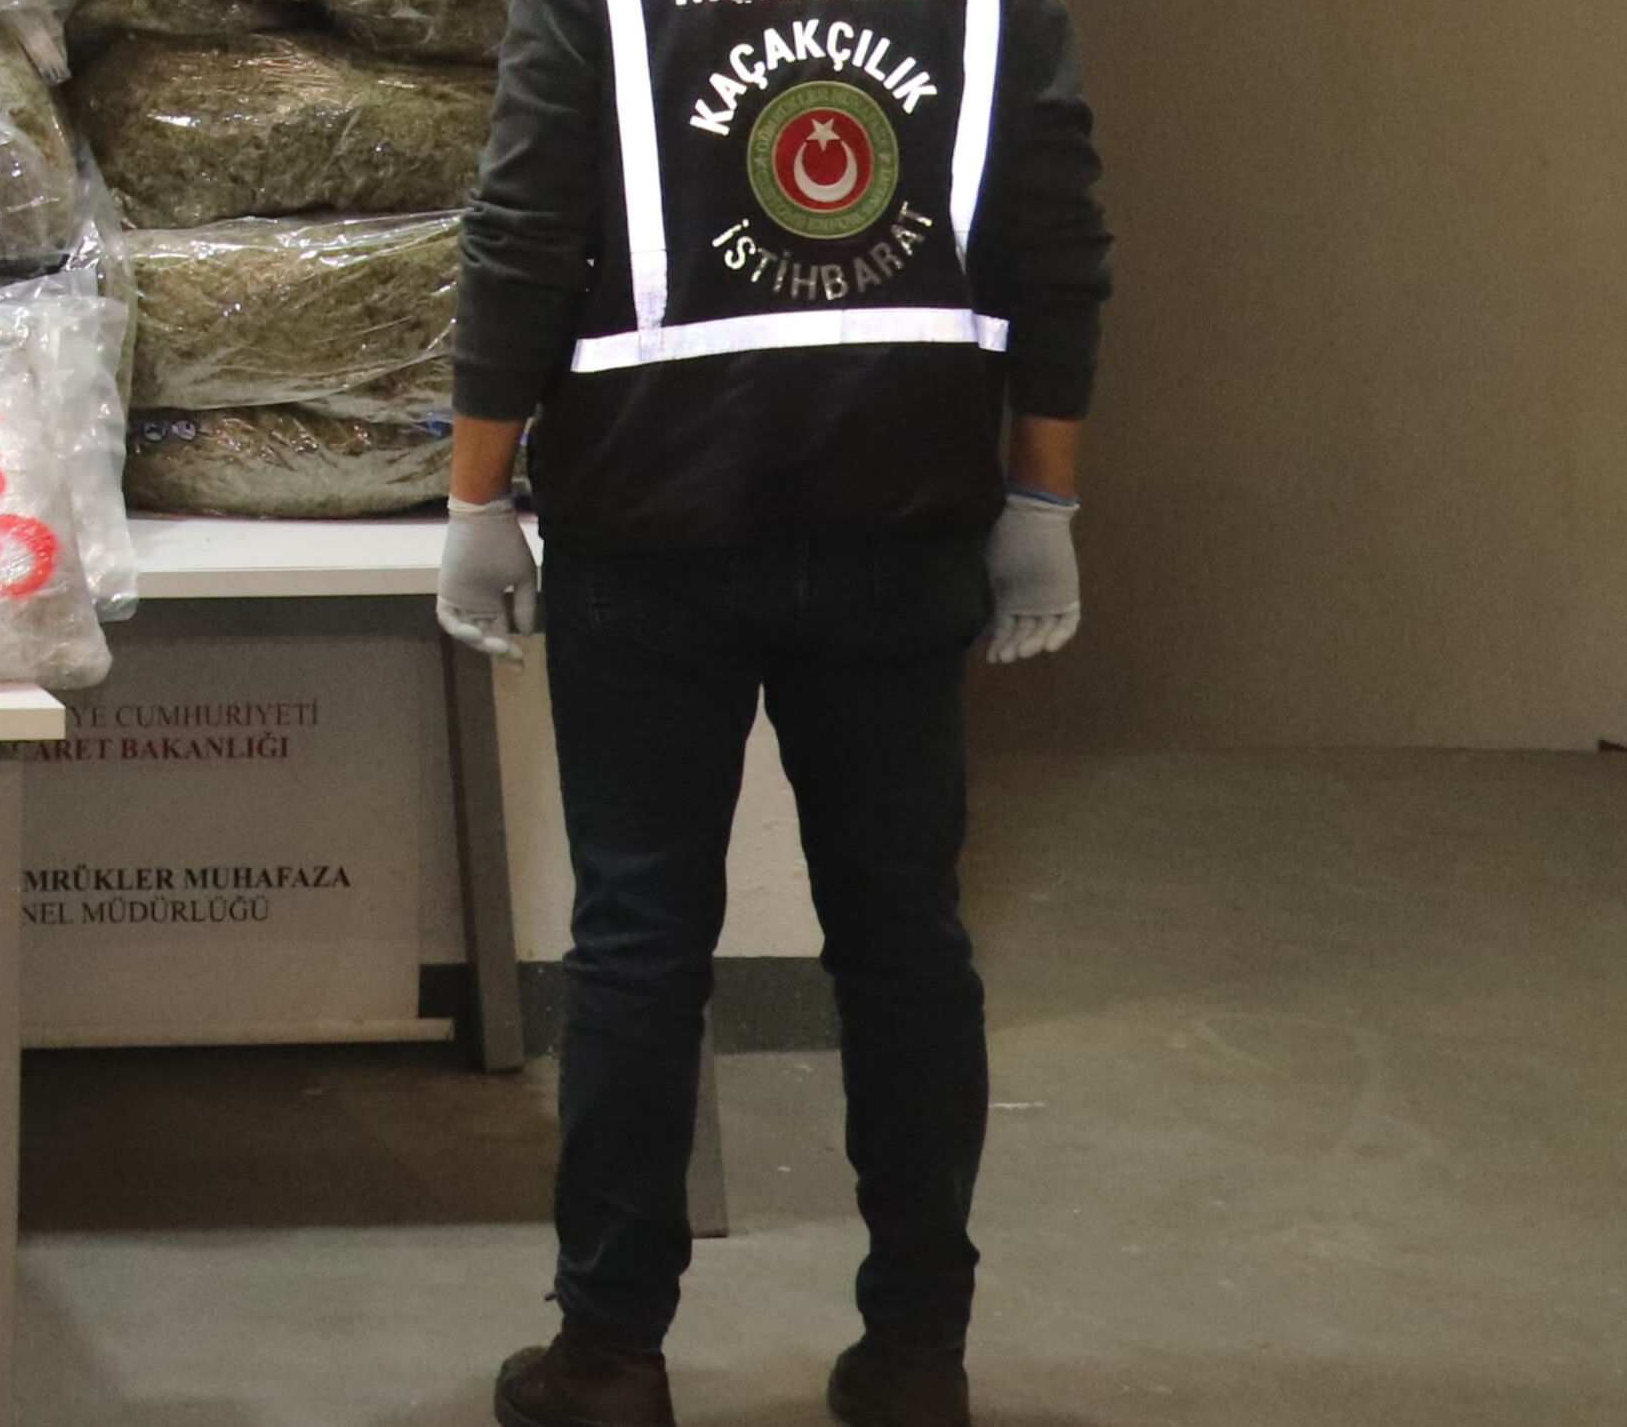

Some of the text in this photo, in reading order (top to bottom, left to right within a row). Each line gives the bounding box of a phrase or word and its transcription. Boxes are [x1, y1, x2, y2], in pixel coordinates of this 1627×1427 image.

[689, 18, 938, 137] KAÇAKÇILIK
[711, 200, 933, 301] İSTİHBARAT
[121, 731, 290, 761] BAKANLIĞI
[184, 865, 351, 890] MUHAFAZA
[82, 894, 270, 924] MÜDÜRLÜĞÜ
